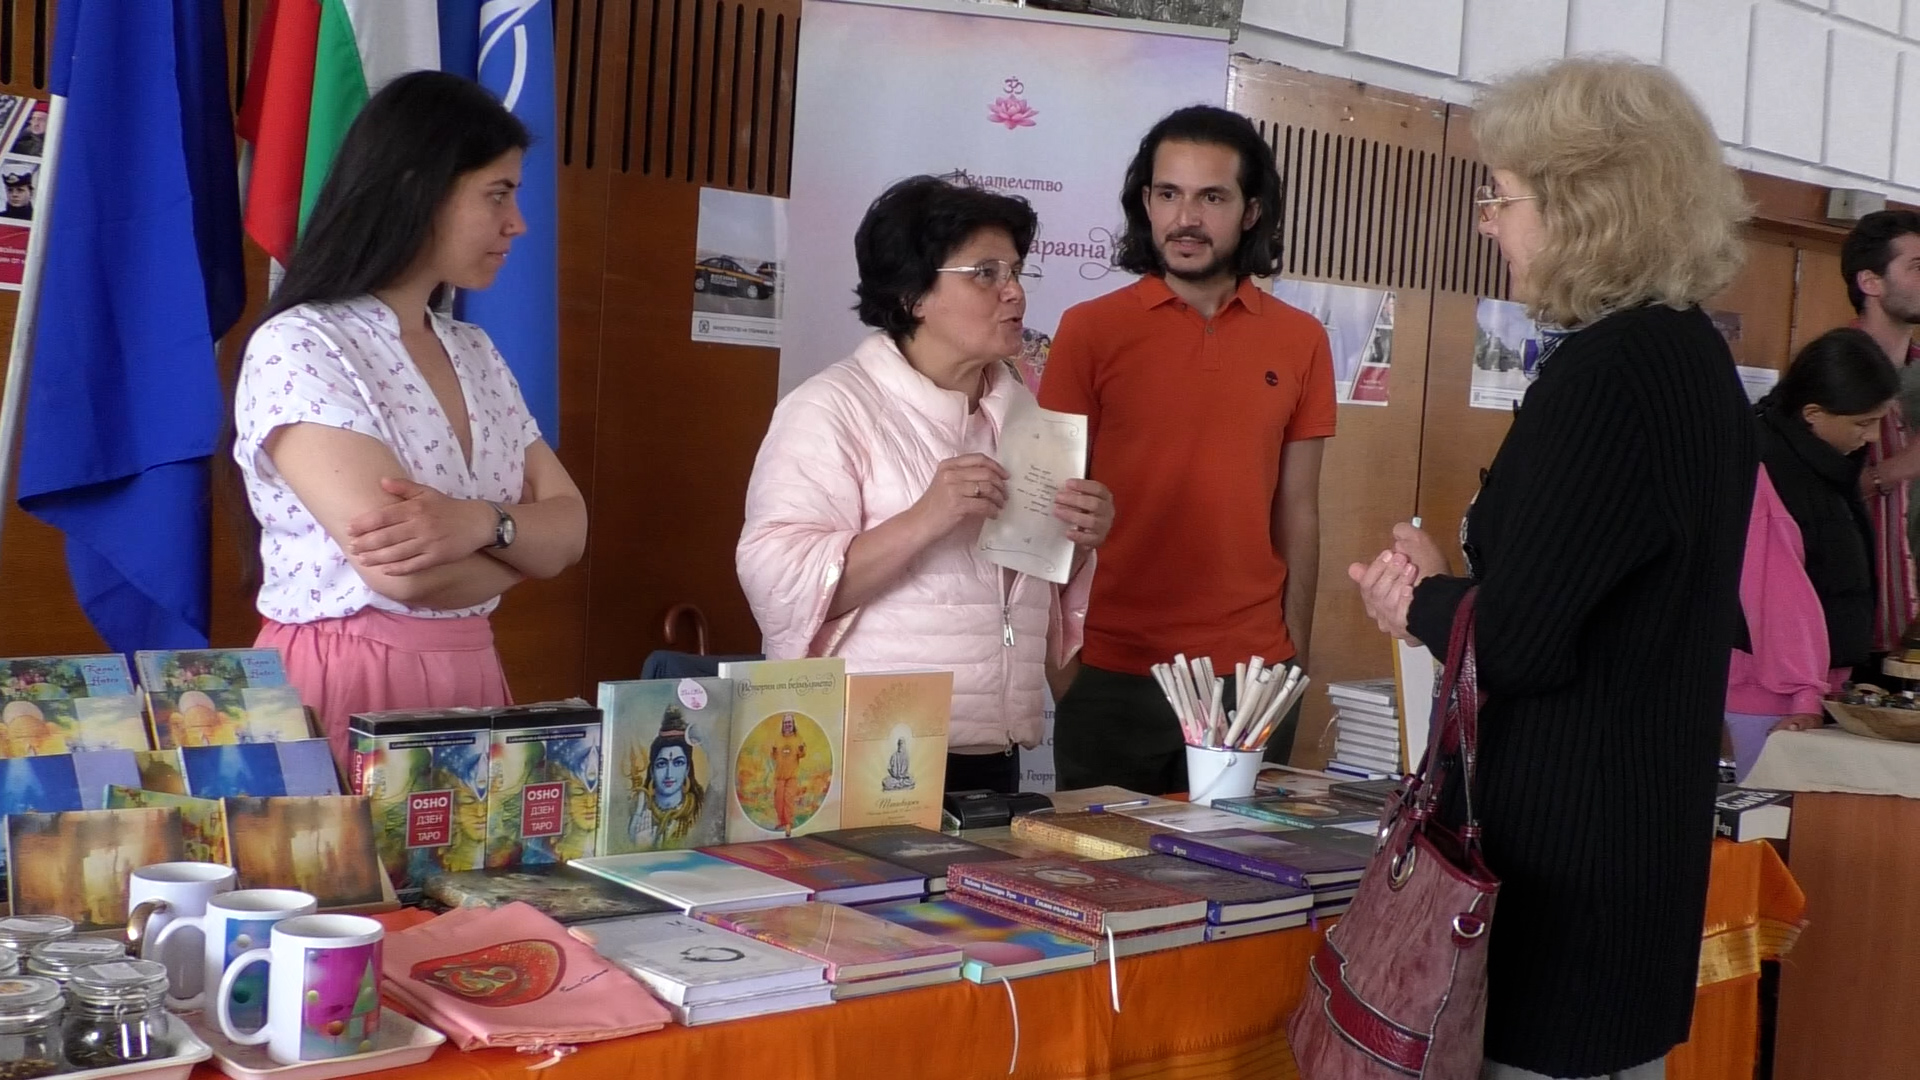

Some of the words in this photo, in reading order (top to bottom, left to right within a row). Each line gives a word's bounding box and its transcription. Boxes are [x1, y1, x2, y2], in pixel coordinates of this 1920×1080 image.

[955, 168, 1063, 192] Издателство
[1029, 239, 1106, 263] араяна
[527, 788, 560, 801] OSHO
[412, 796, 448, 809] OSHO
[530, 805, 555, 817] ДЗЕН
[415, 814, 443, 826] ДЗЕН
[531, 821, 553, 831] ТАРО
[417, 831, 441, 841] ТАРО
